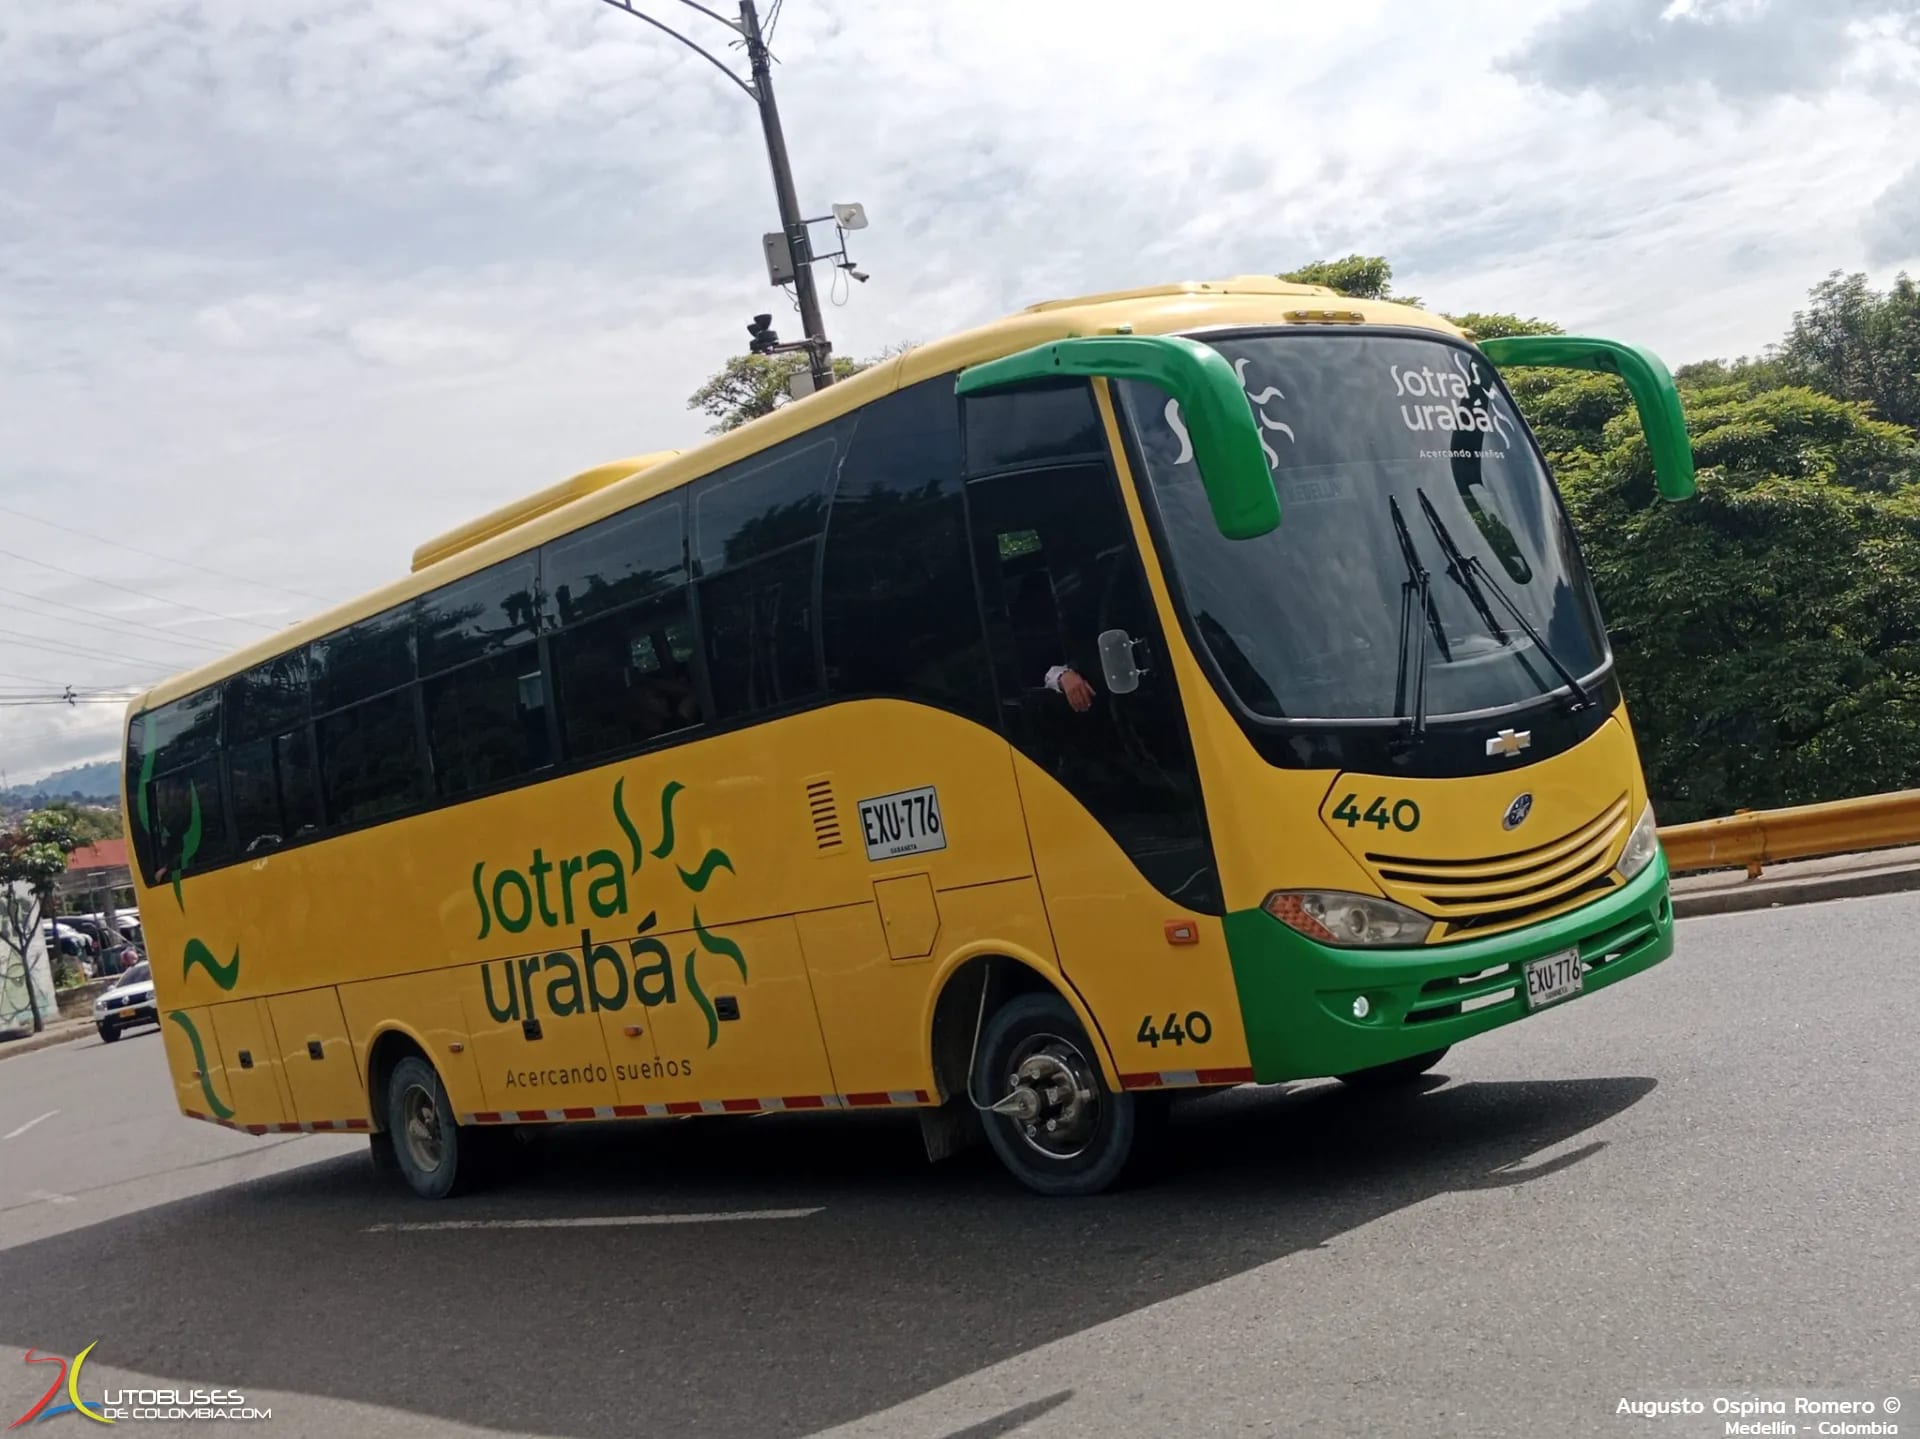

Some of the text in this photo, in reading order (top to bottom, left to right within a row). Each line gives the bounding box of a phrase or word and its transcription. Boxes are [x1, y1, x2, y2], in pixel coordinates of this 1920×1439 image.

[1390, 364, 1470, 399] Sotra
[1400, 398, 1494, 432] urabá
[1419, 448, 1472, 459] Acercando
[1331, 792, 1421, 833] 440
[472, 848, 628, 940] Sotra
[480, 910, 677, 1023] urabá
[1136, 1010, 1213, 1049] 440
[505, 1056, 693, 1089] Acercando sueños
